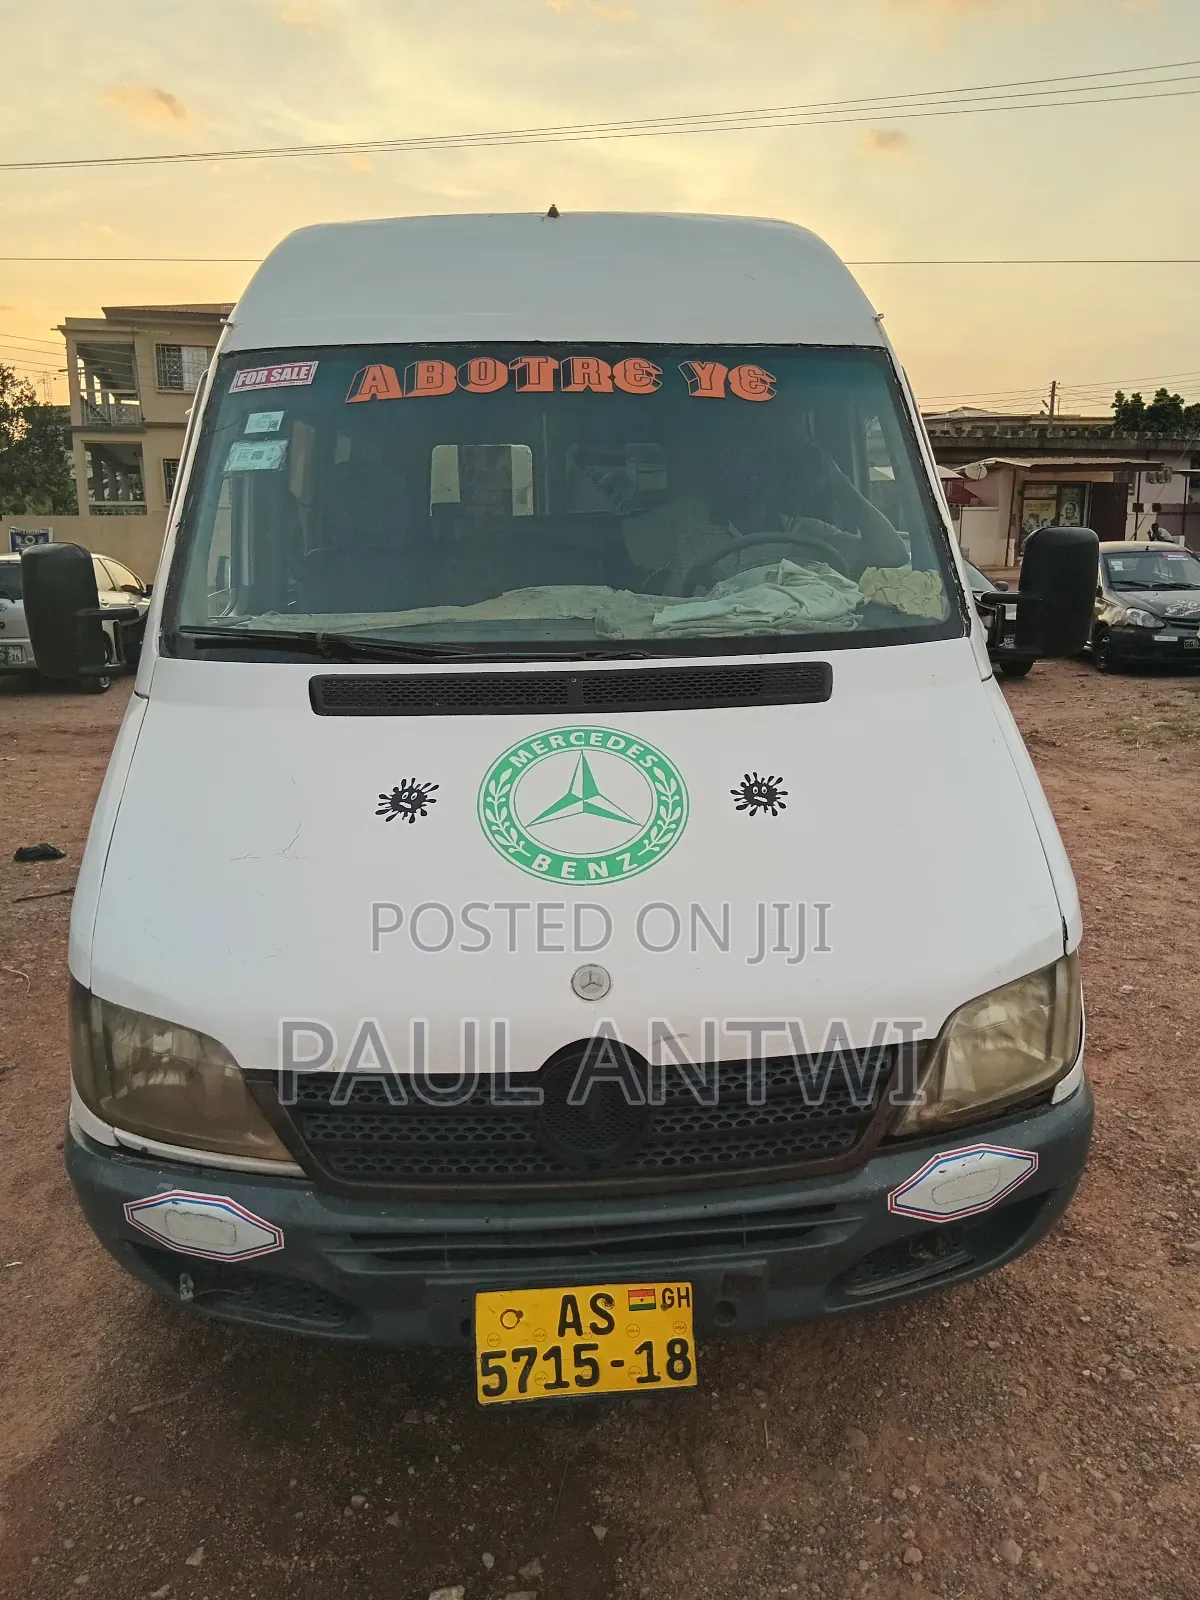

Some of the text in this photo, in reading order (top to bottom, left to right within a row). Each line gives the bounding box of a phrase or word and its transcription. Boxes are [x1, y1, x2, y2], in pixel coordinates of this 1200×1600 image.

[237, 366, 311, 386] FOR SALE
[508, 731, 659, 769] MERCEDES
[531, 852, 639, 880] BENZ
[557, 1286, 691, 1338] AS GH
[480, 1337, 693, 1397] 5715-18
